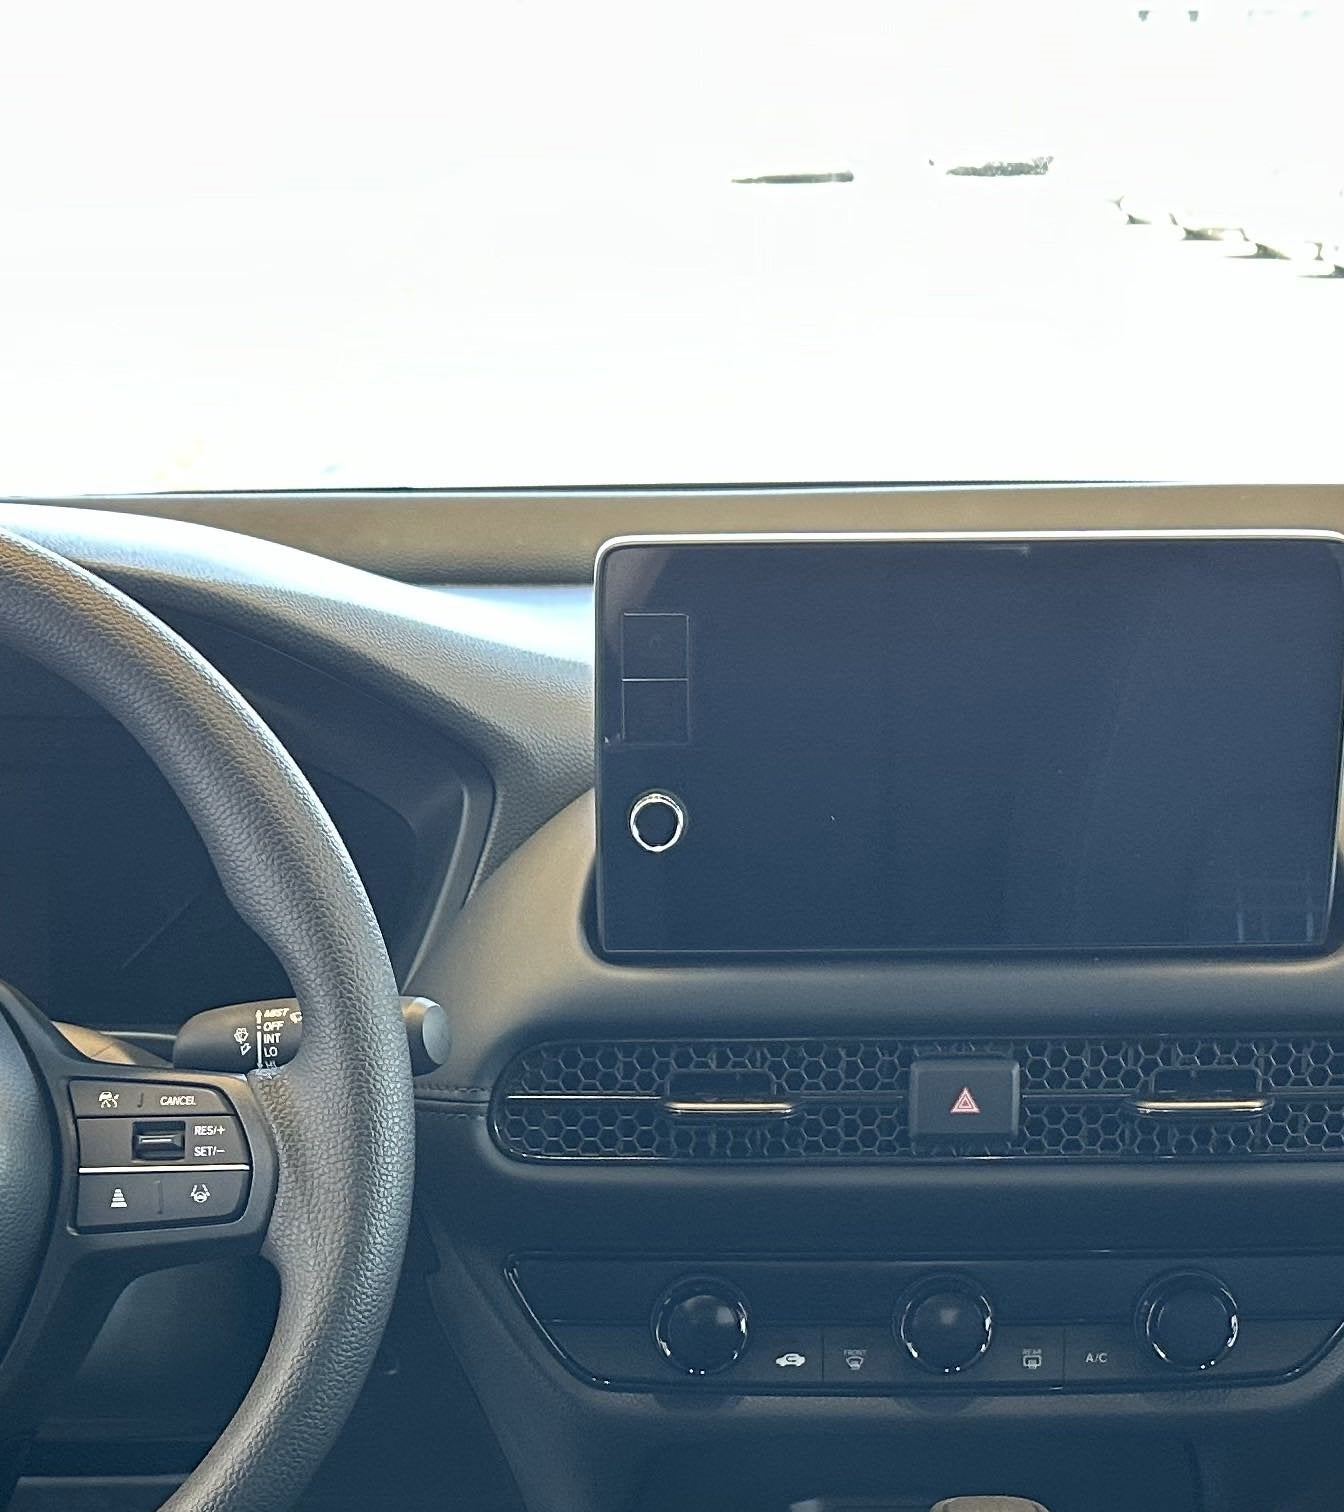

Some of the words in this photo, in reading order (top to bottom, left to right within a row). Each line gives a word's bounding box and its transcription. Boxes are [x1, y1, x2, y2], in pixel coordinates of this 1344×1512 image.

[263, 1021, 284, 1031] OFF
[263, 1032, 281, 1044] INT
[263, 1046, 278, 1057] LO
[159, 1095, 196, 1106] CANCEL
[1085, 1352, 1108, 1363] A/C
